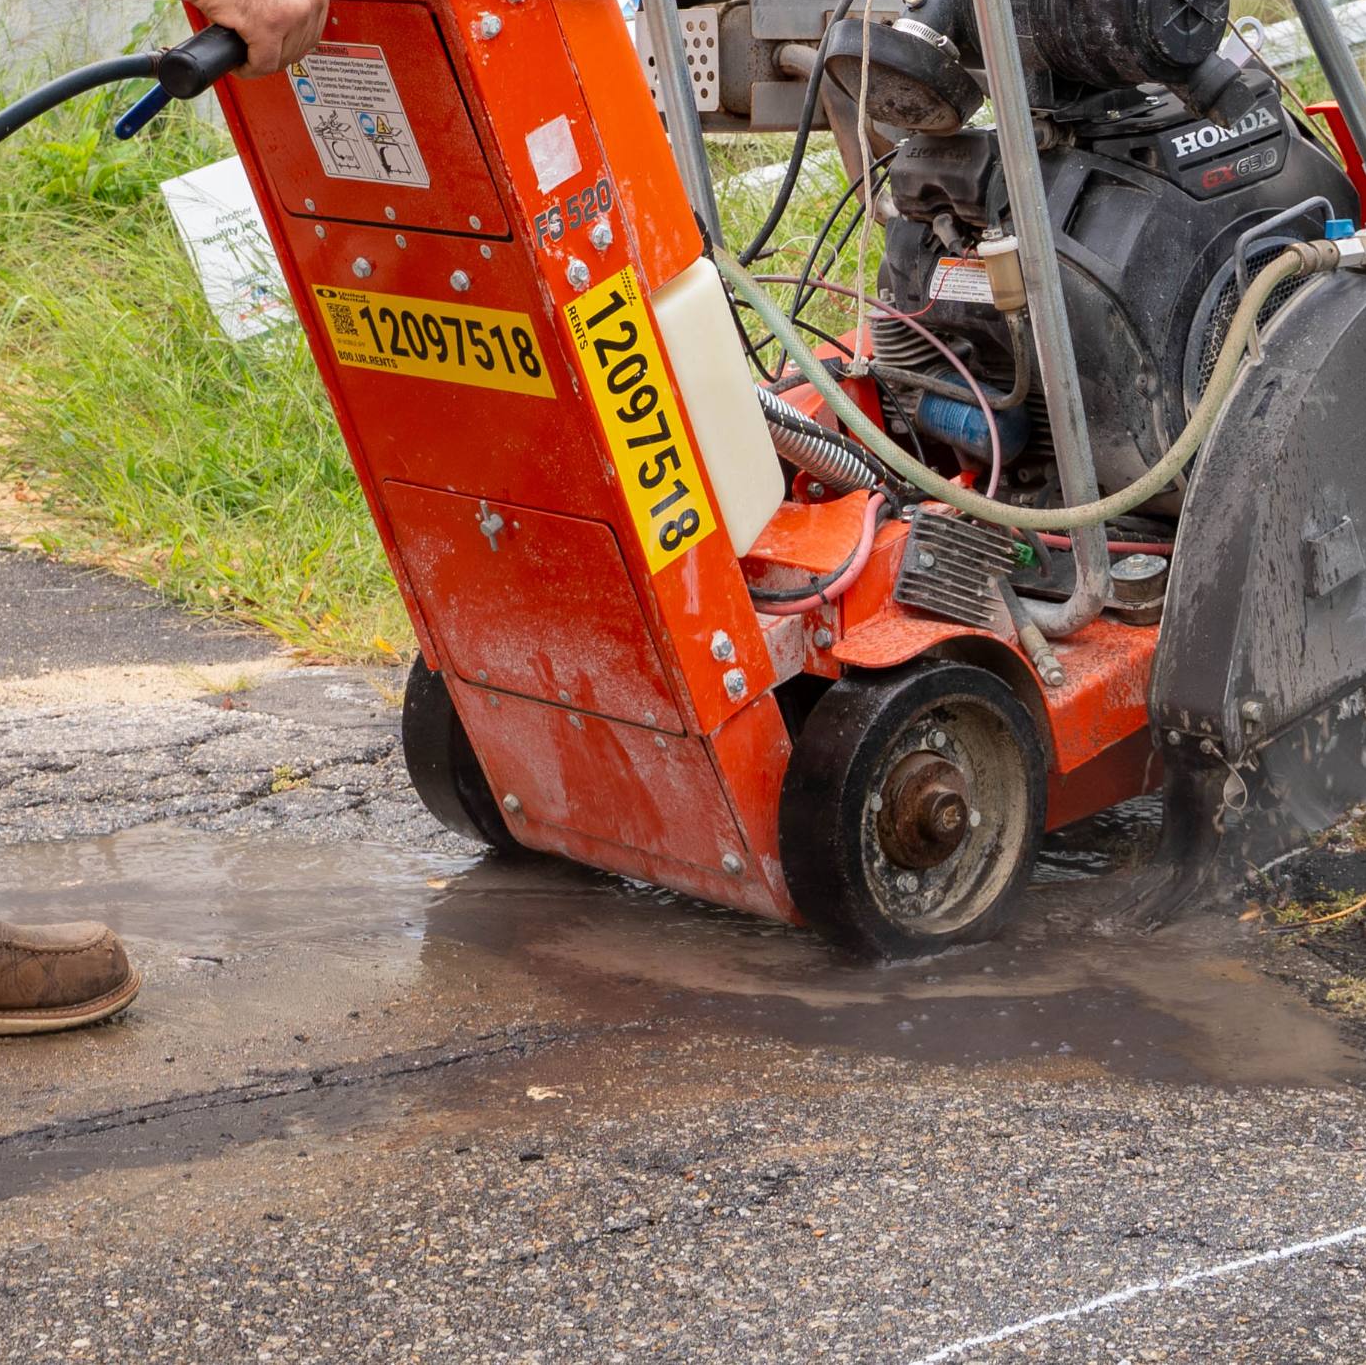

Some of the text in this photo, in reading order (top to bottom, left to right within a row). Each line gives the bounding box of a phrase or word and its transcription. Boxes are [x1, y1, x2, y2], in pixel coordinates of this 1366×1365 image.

[1171, 107, 1279, 158] HONDA
[202, 225, 238, 246] quality
[215, 206, 252, 226] Another
[533, 177, 613, 249] FS 520
[359, 306, 542, 379] 12097518
[586, 290, 701, 552] 12097518
